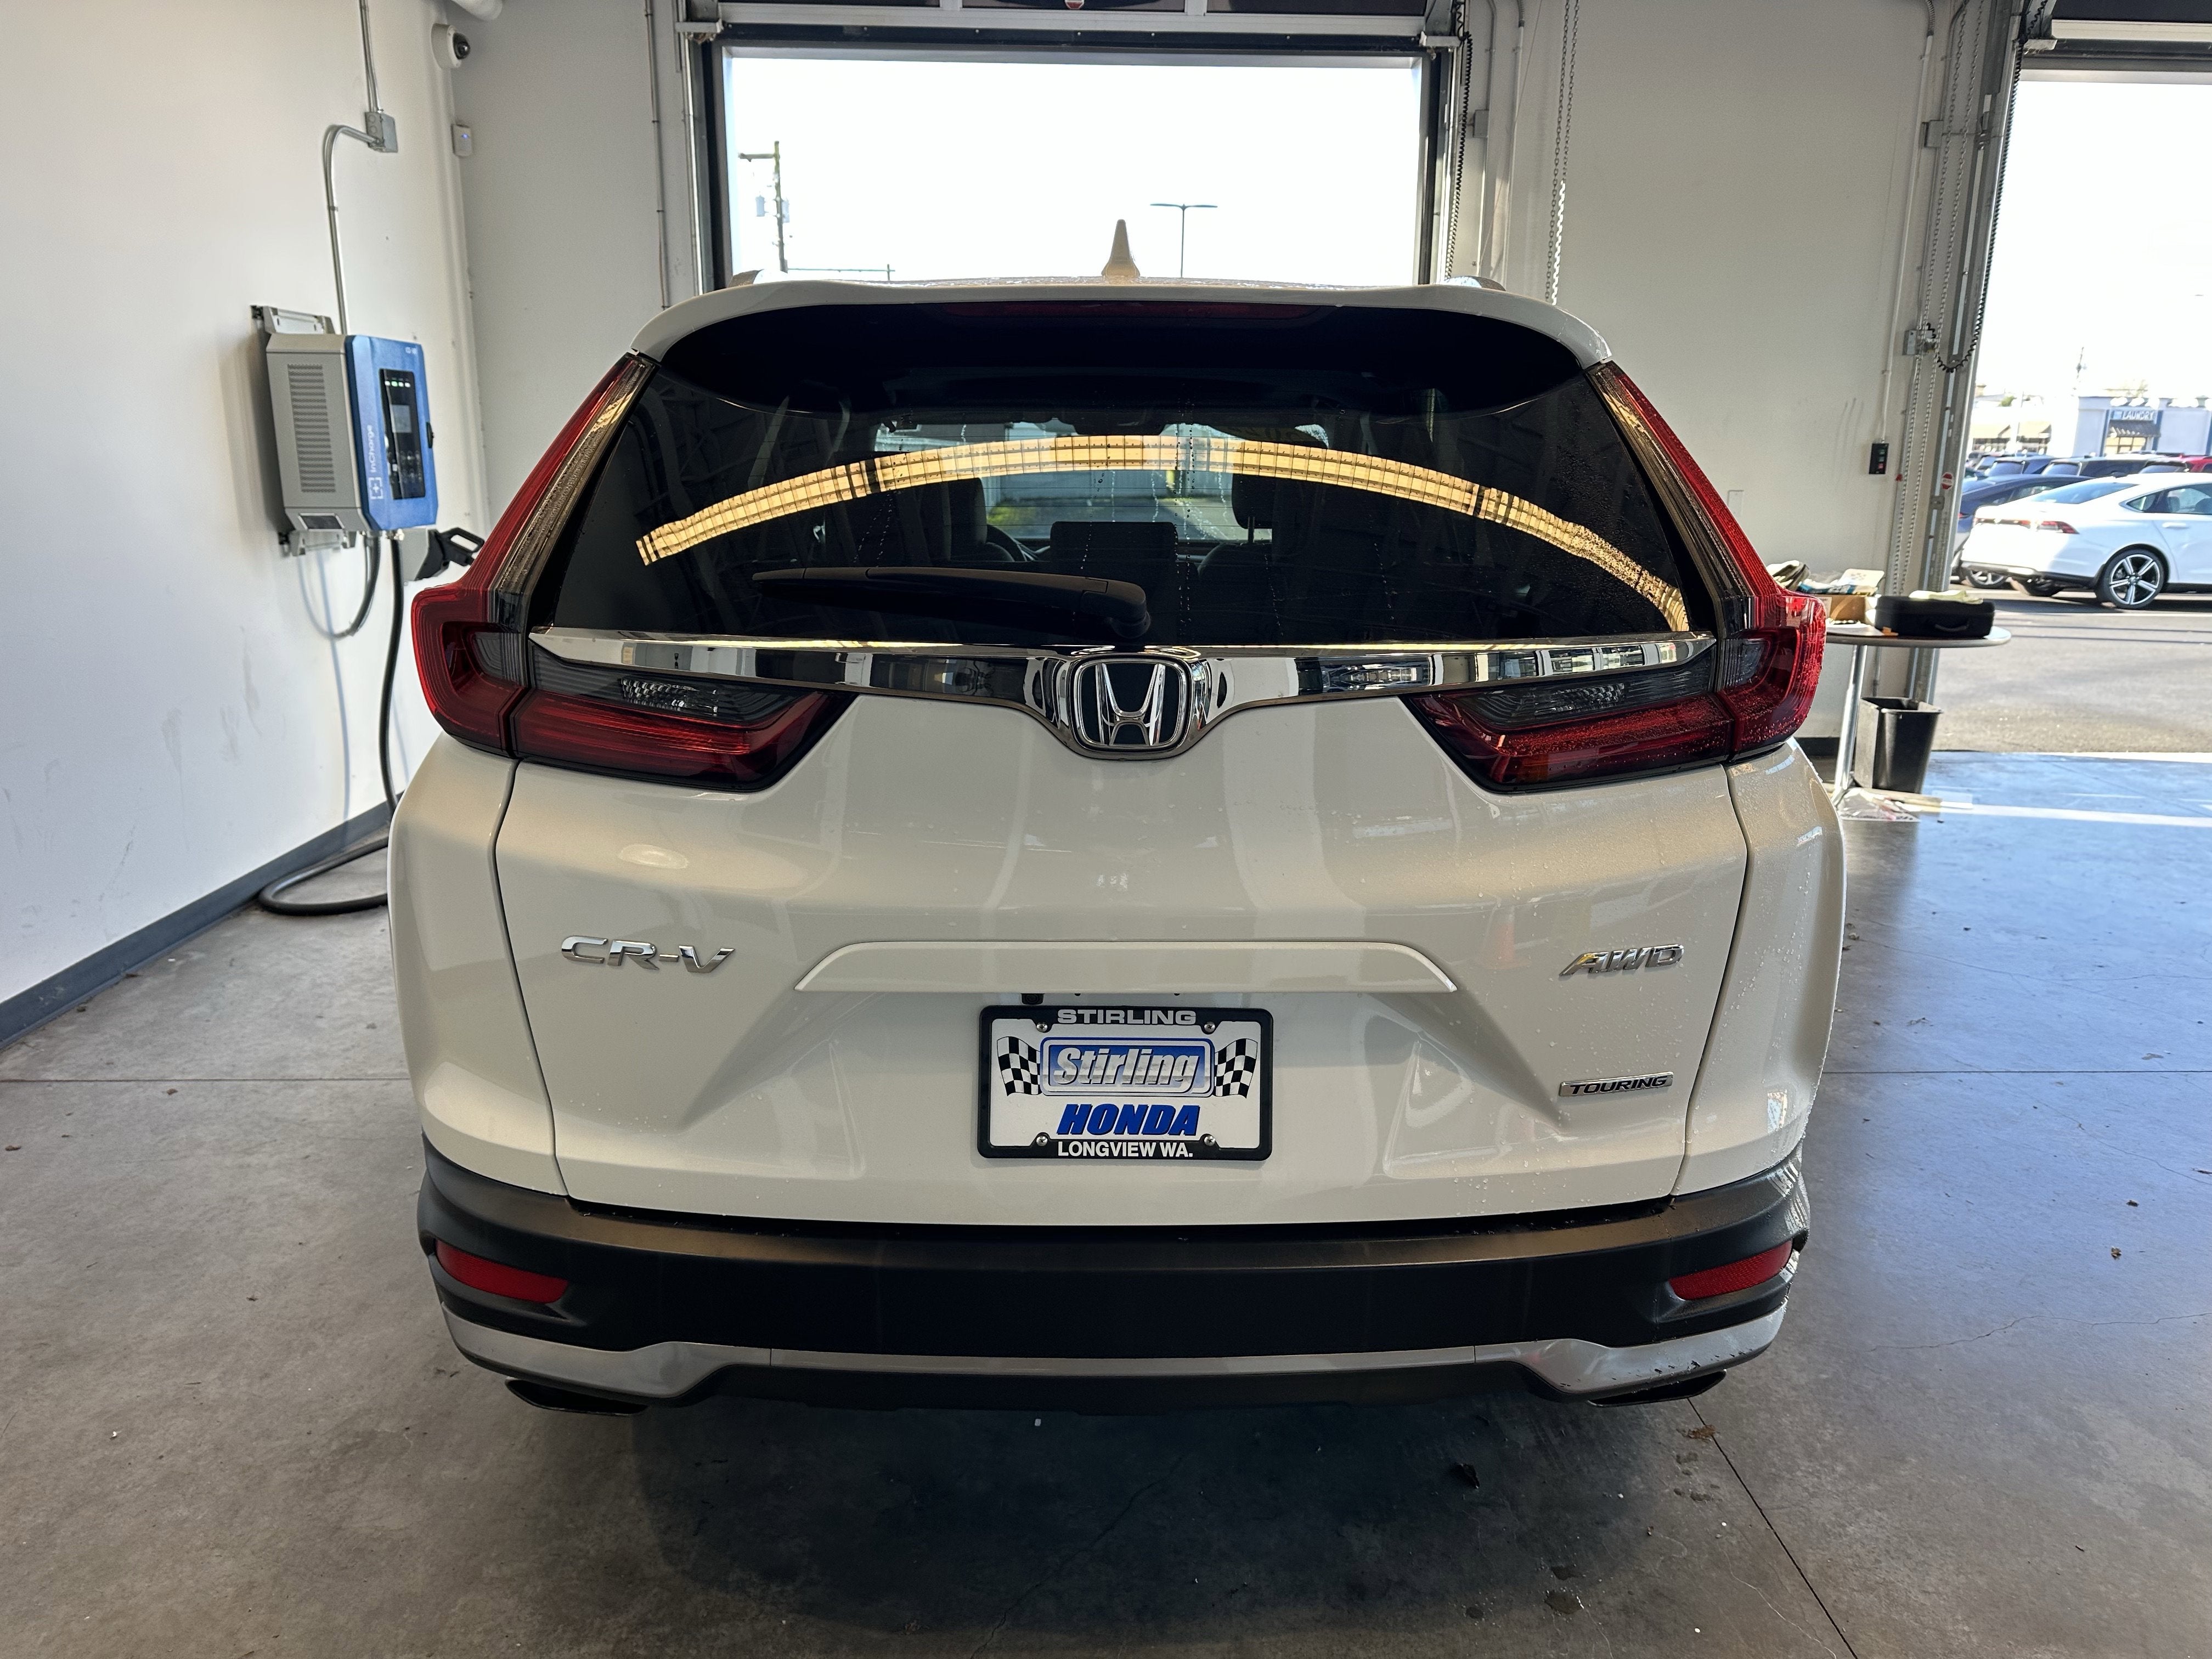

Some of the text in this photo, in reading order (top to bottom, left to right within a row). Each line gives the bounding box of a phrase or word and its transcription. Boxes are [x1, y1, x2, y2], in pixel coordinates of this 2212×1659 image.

[2122, 410, 2154, 420] LAUNDRY
[561, 935, 735, 973] CR-V
[1559, 944, 1684, 977] AWD
[1057, 1009, 1196, 1025] STIRLING
[1053, 1047, 1199, 1093] Stirling
[1570, 1075, 1668, 1094] TOURING
[1056, 1103, 1200, 1136] HONDA
[1058, 1141, 1193, 1158] LONGVIEW WA.
